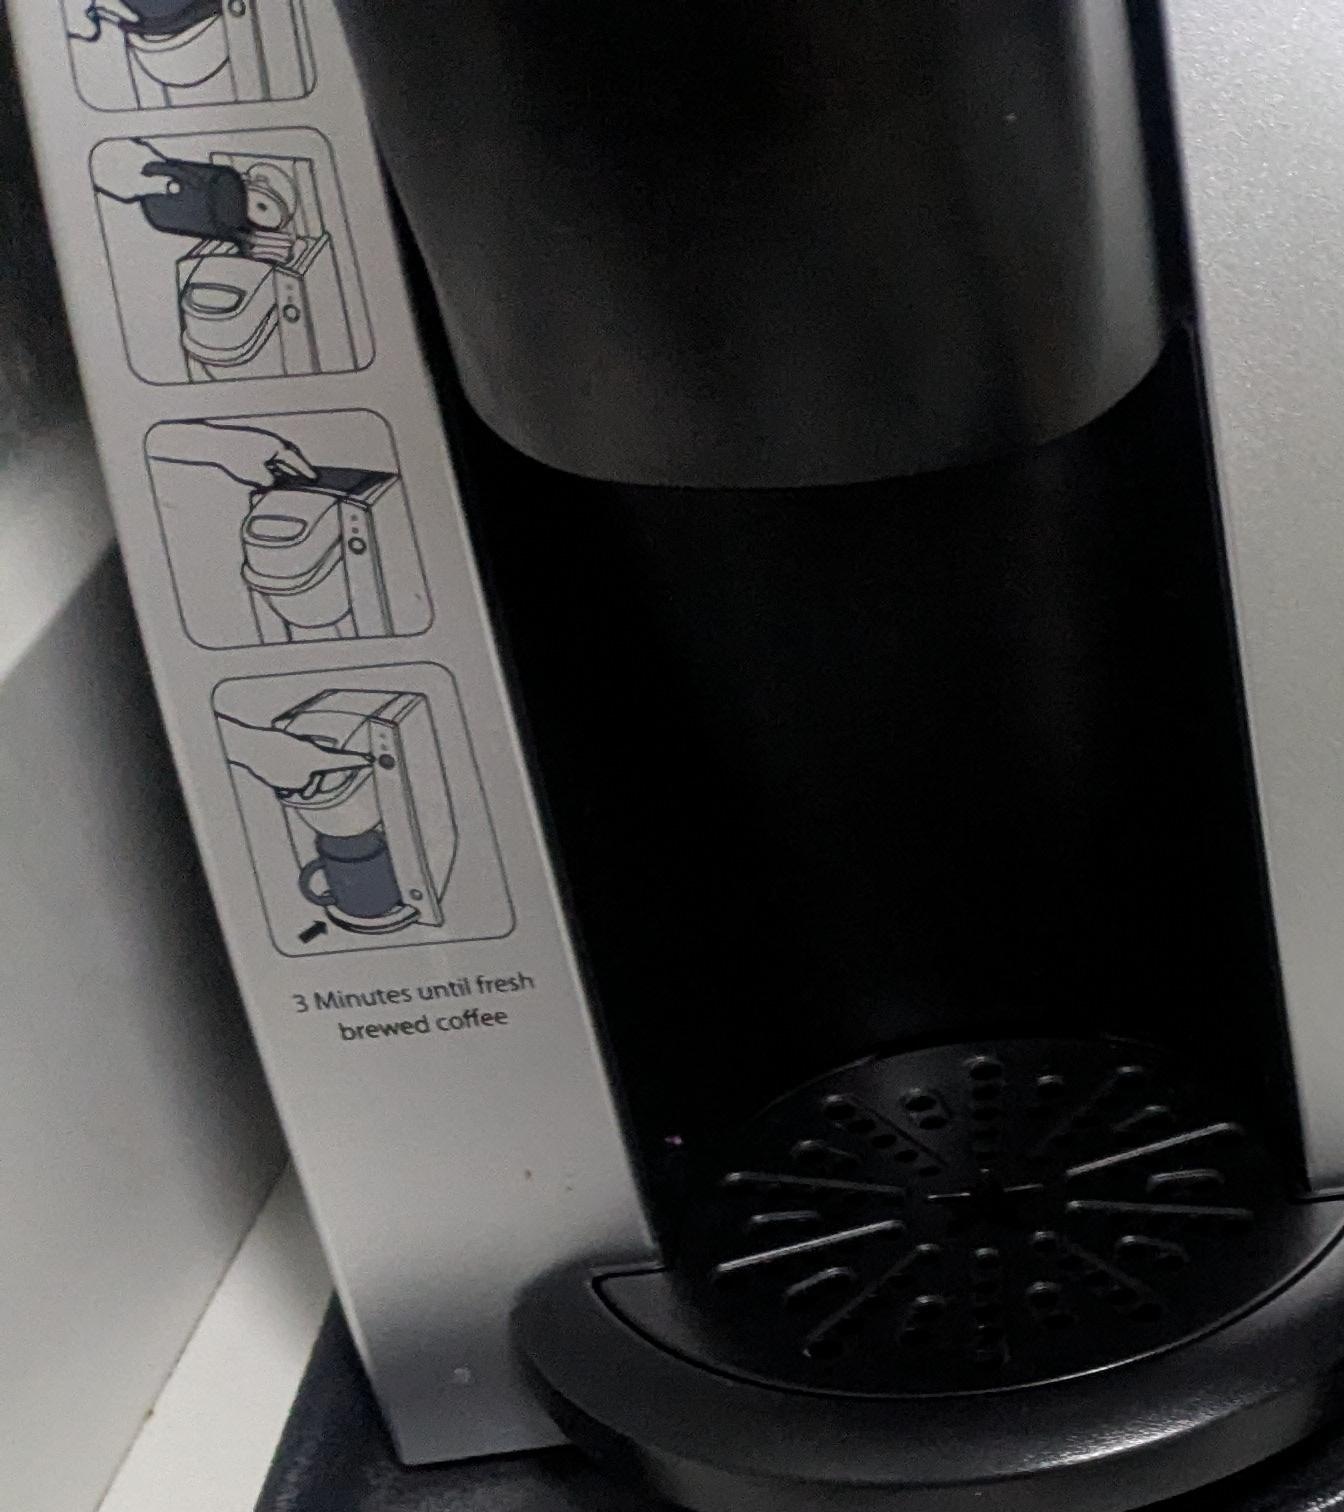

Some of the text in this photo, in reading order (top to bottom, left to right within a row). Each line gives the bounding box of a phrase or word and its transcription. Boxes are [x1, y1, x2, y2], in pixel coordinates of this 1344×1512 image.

[296, 971, 535, 1013] 3 Minutes until fresh
[339, 1008, 509, 1041] brewed coffee
